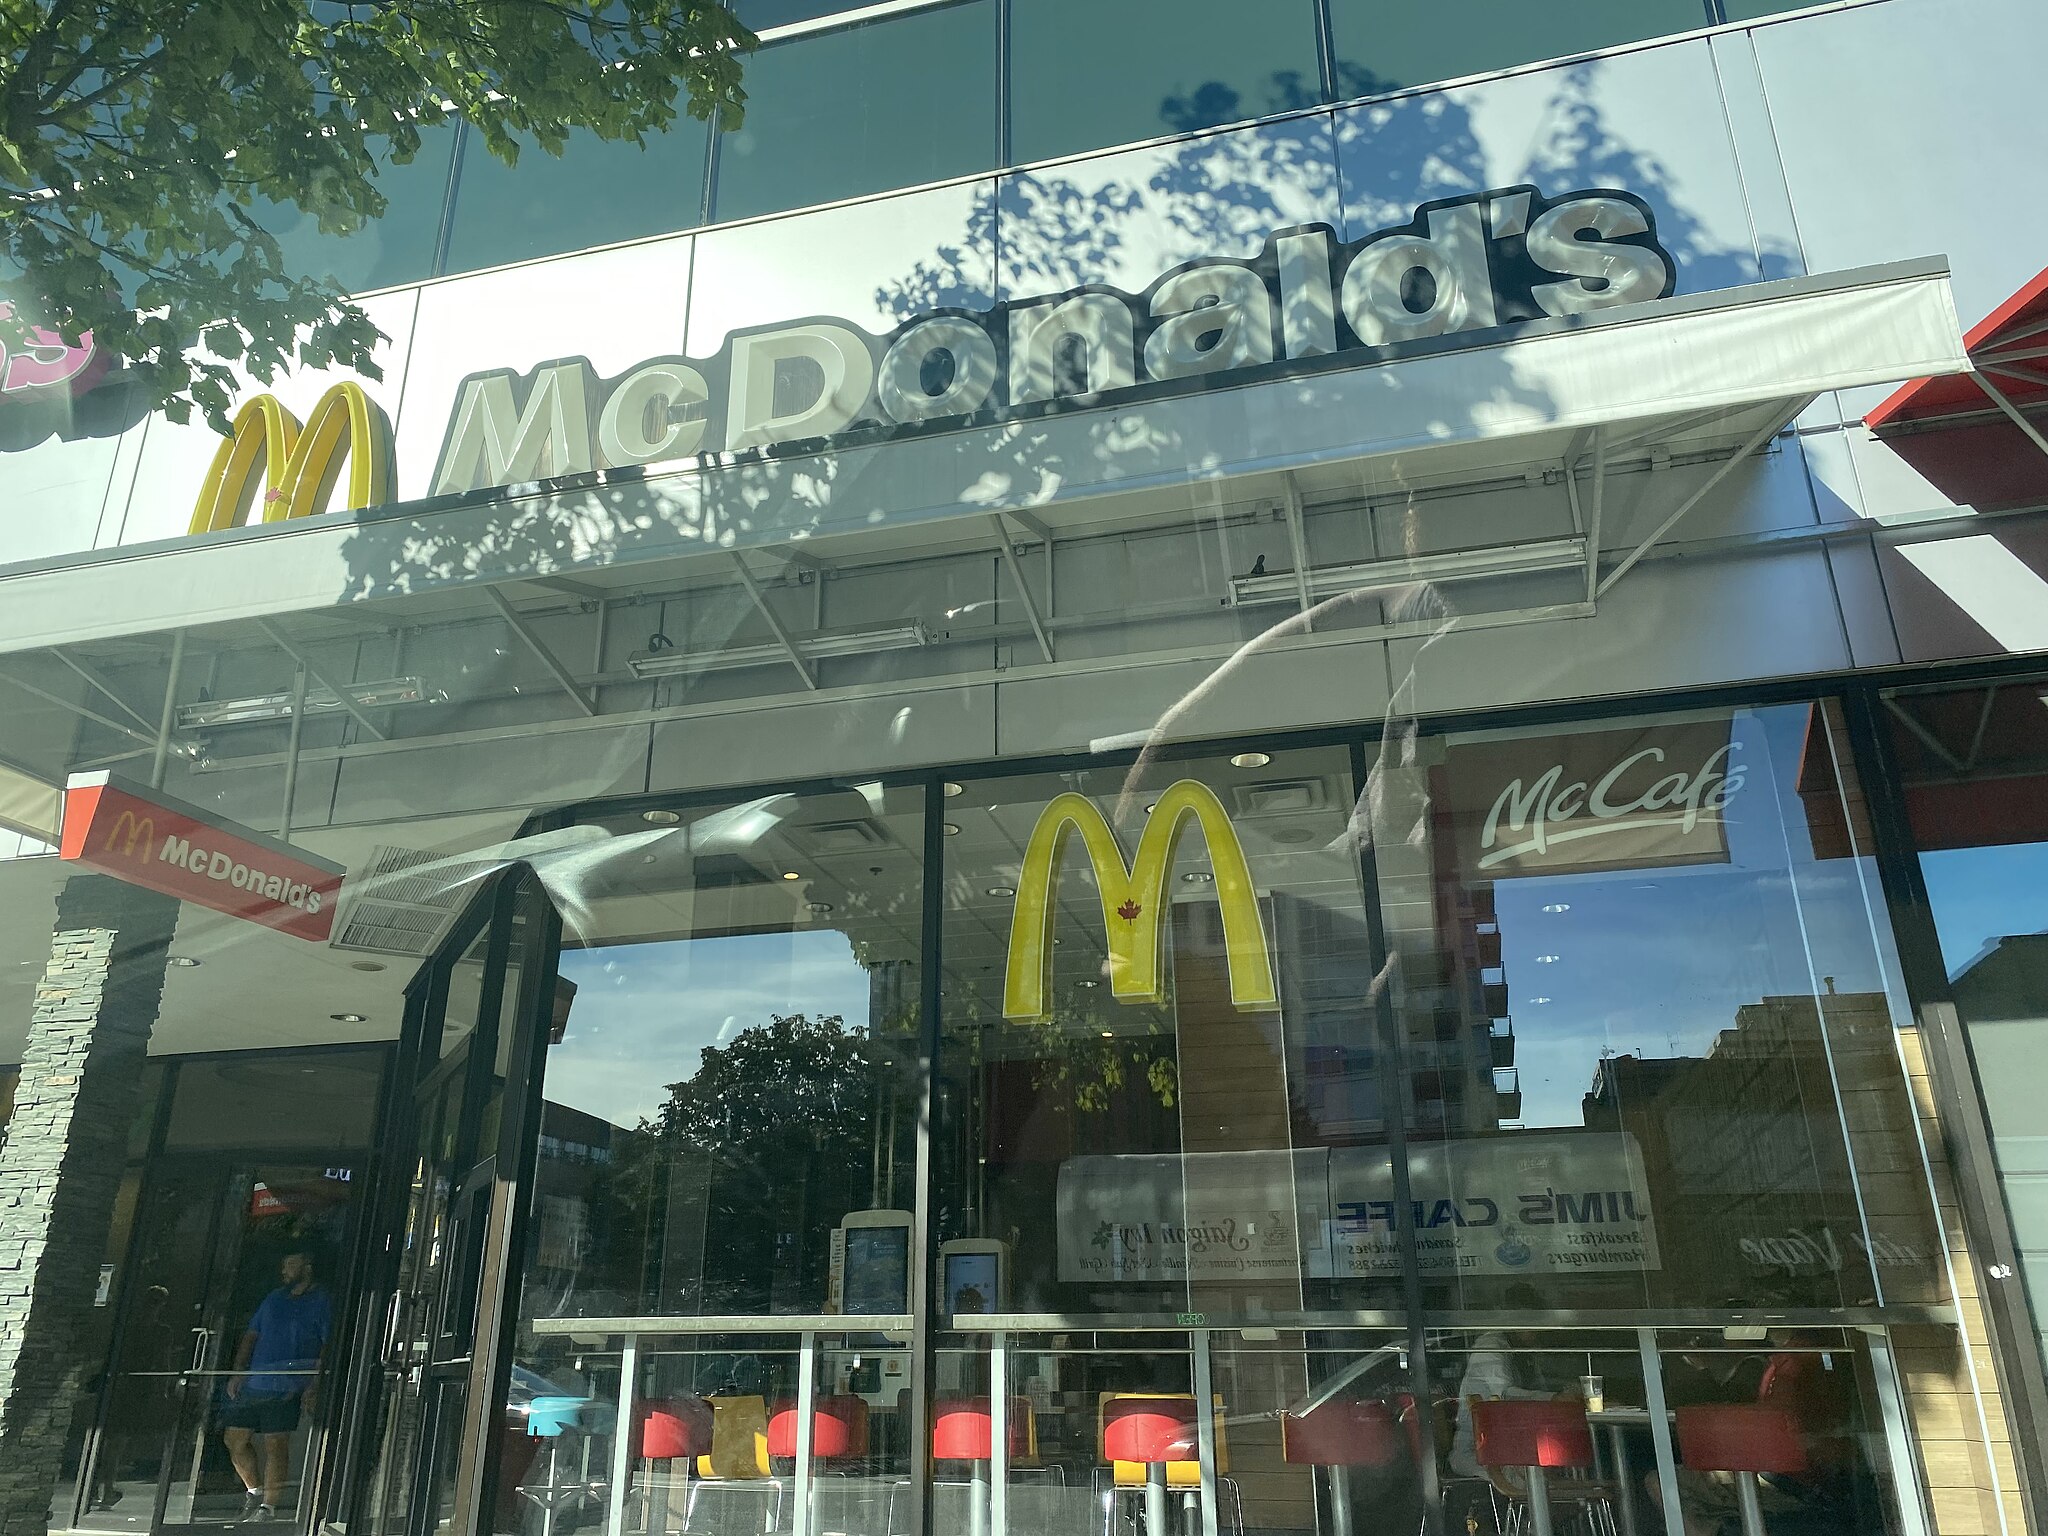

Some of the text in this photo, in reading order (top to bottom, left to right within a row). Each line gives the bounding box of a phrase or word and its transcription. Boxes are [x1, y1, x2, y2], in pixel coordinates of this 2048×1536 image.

[432, 188, 1670, 497] McDonald's
[1480, 742, 1748, 866] McCafé
[159, 834, 322, 914] McDonald's
